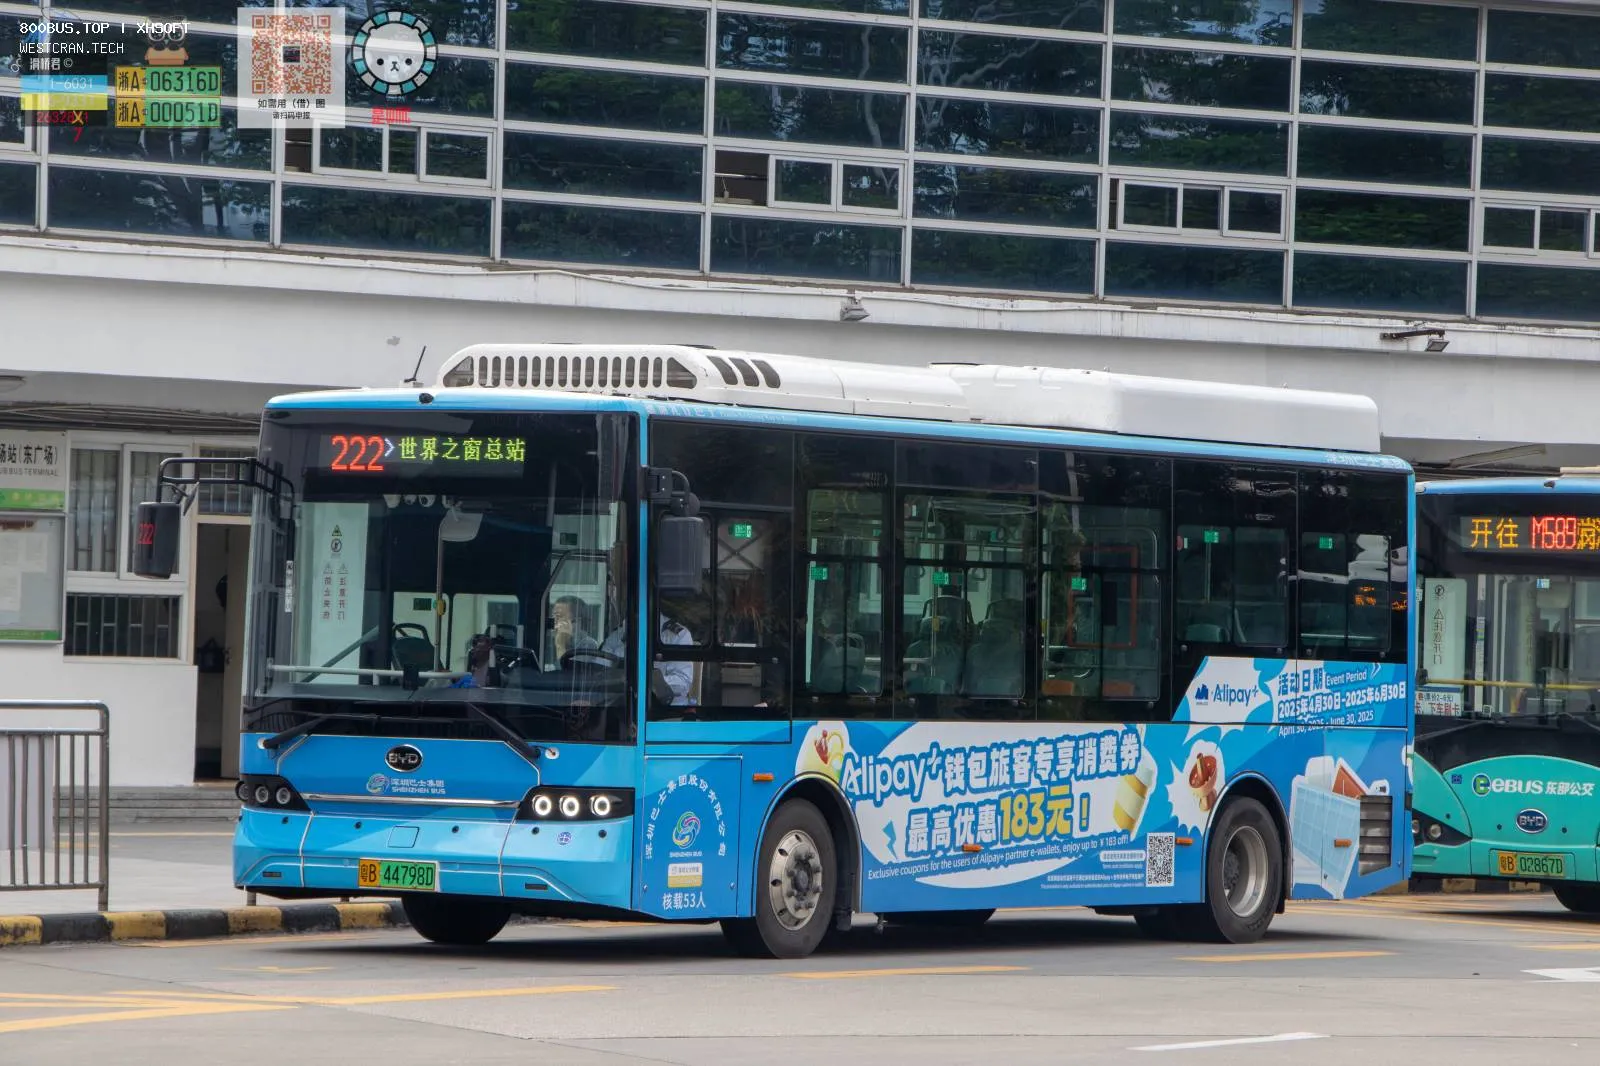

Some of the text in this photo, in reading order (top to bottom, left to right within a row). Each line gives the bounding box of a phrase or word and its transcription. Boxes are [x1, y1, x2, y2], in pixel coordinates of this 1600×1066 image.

[331, 435, 385, 471] 222
[398, 437, 526, 463] 世界之窗总站
[1471, 518, 1519, 549] 开往
[1213, 683, 1259, 707] Alipay+
[1278, 667, 1367, 697] 活动日期 Event Period
[1278, 725, 1296, 738] April
[1330, 715, 1345, 726] June
[1346, 713, 1357, 725] 30,
[1358, 710, 1374, 723] 2025
[388, 752, 420, 764] BYD
[1518, 815, 1544, 825] BYD
[868, 866, 899, 880] Exclusive
[900, 862, 929, 877] coupons
[930, 860, 940, 871] for
[940, 858, 952, 869] the
[953, 856, 971, 868] users
[971, 853, 980, 865] of
[980, 851, 1005, 864] Alipay+
[1005, 849, 1030, 861] partner
[1030, 844, 1062, 857] e-wallets,
[1062, 842, 1081, 853] enjoy
[1081, 841, 1090, 851] up
[1091, 840, 1098, 849] to
[1117, 834, 1129, 845] off!
[662, 891, 706, 910] 核载53人
